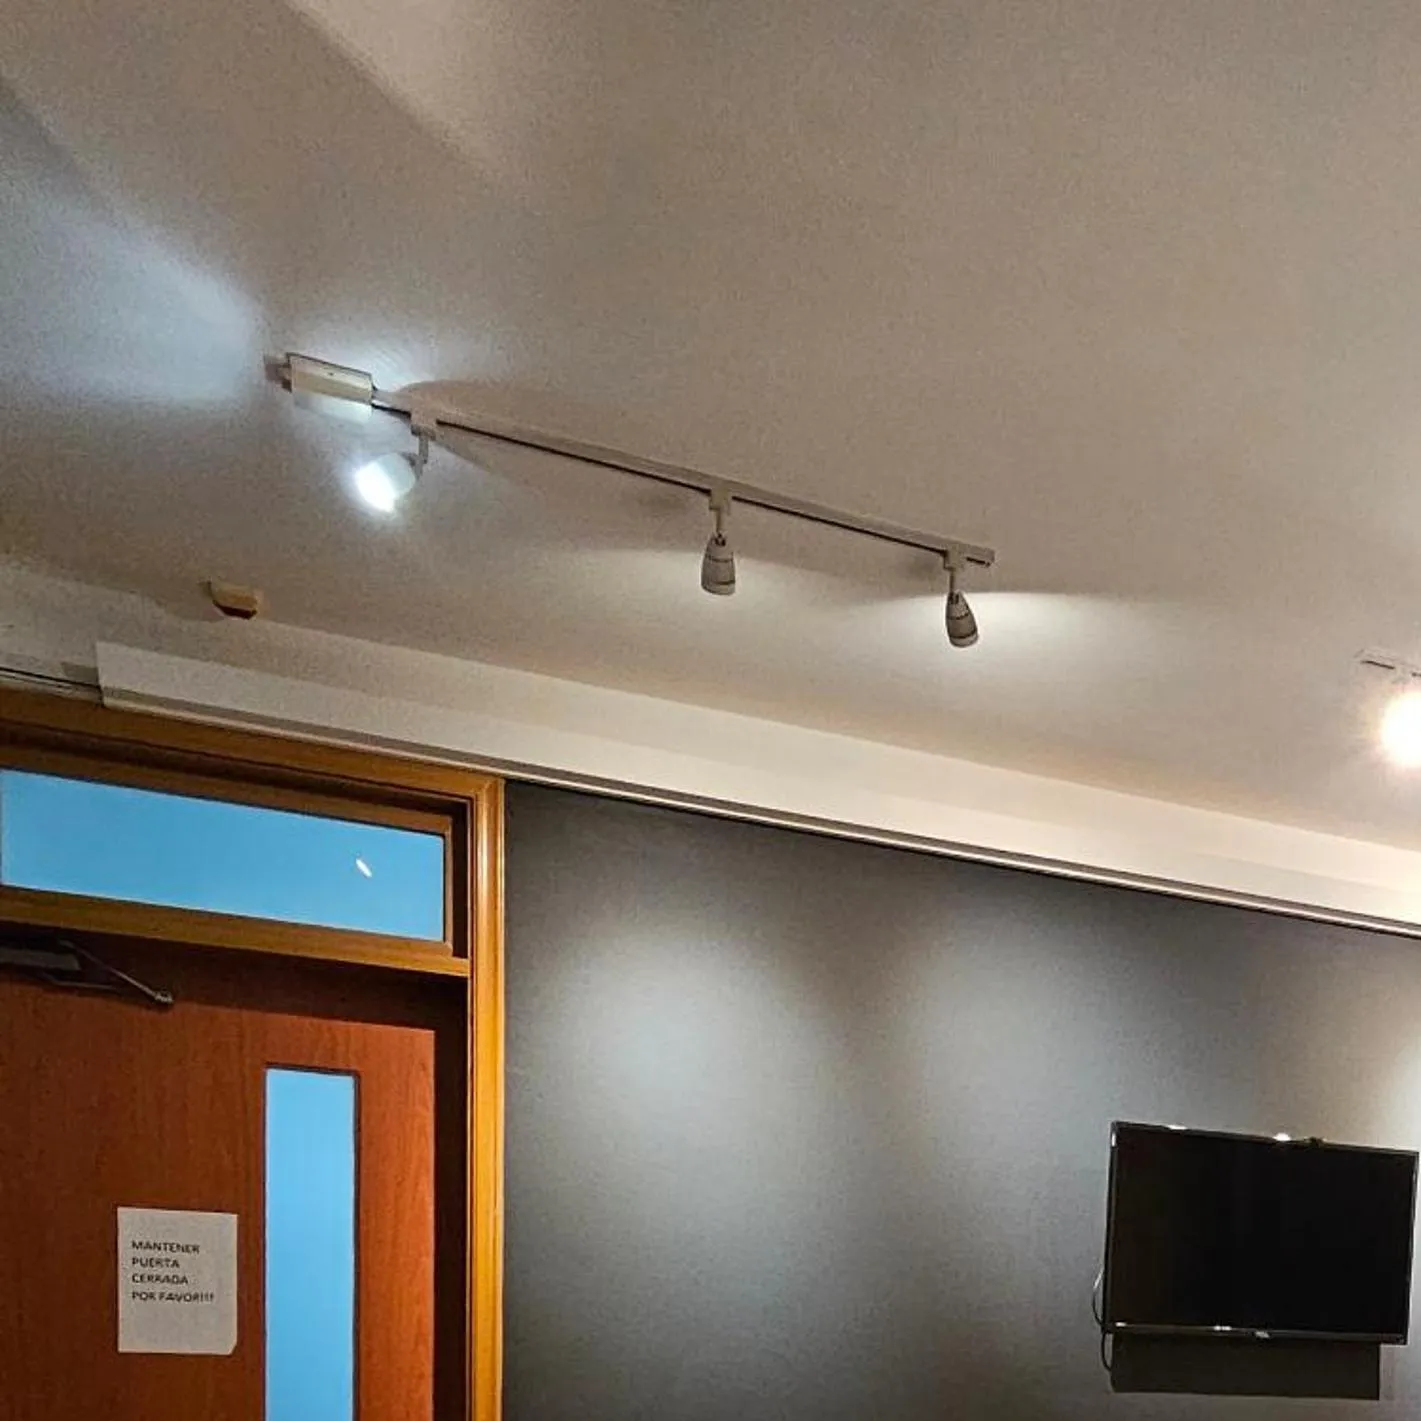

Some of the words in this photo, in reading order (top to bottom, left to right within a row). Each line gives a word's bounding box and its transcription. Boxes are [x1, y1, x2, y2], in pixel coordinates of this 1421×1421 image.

[131, 1240, 201, 1255] MANTENER
[131, 1257, 180, 1268] PUERTA
[131, 1273, 189, 1284] CERRADA
[131, 1291, 156, 1301] POR
